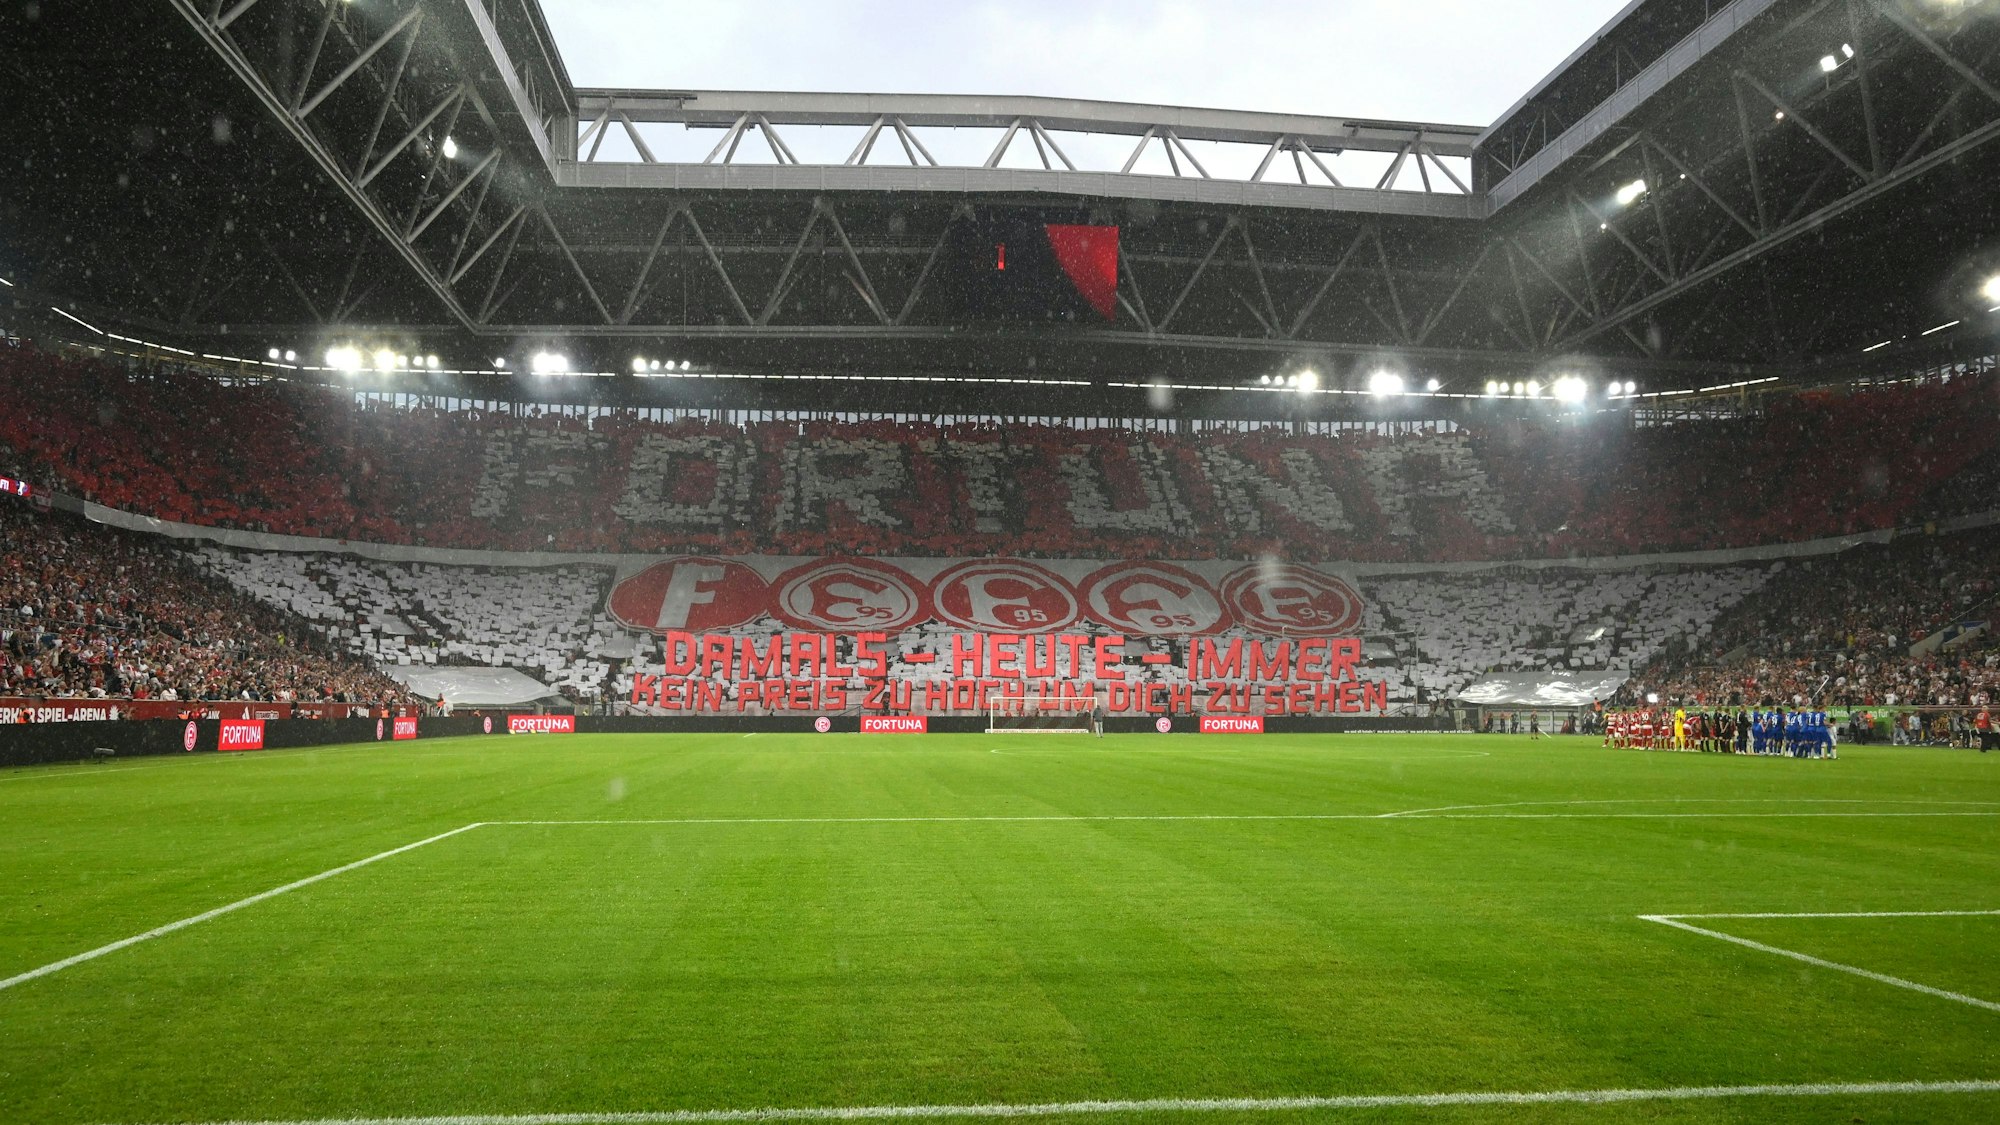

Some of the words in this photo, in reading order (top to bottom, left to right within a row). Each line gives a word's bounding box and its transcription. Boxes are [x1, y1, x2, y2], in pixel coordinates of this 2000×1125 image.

[655, 563, 726, 629] F
[855, 605, 893, 620] 95
[1013, 608, 1048, 622] 95
[664, 630, 888, 680] DAMALS
[952, 633, 1125, 680] HEUTE
[1187, 637, 1361, 682] IMMER
[631, 672, 723, 712] KEIN
[737, 679, 848, 712] PREIS
[861, 679, 912, 711] ZU
[925, 680, 1025, 711] HOCH
[1038, 680, 1094, 712] UM
[1108, 681, 1193, 713] DICH
[1205, 681, 1251, 713] ZU
[1264, 680, 1388, 715] SEHEN
[37, 707, 107, 723] SPIEL-ARENA
[394, 721, 416, 735] FORTUNA
[511, 718, 570, 730] FORTUNA
[865, 719, 923, 730] FORTUNA
[1204, 719, 1259, 730] FORTUNA
[222, 725, 262, 744] FORTUNA
